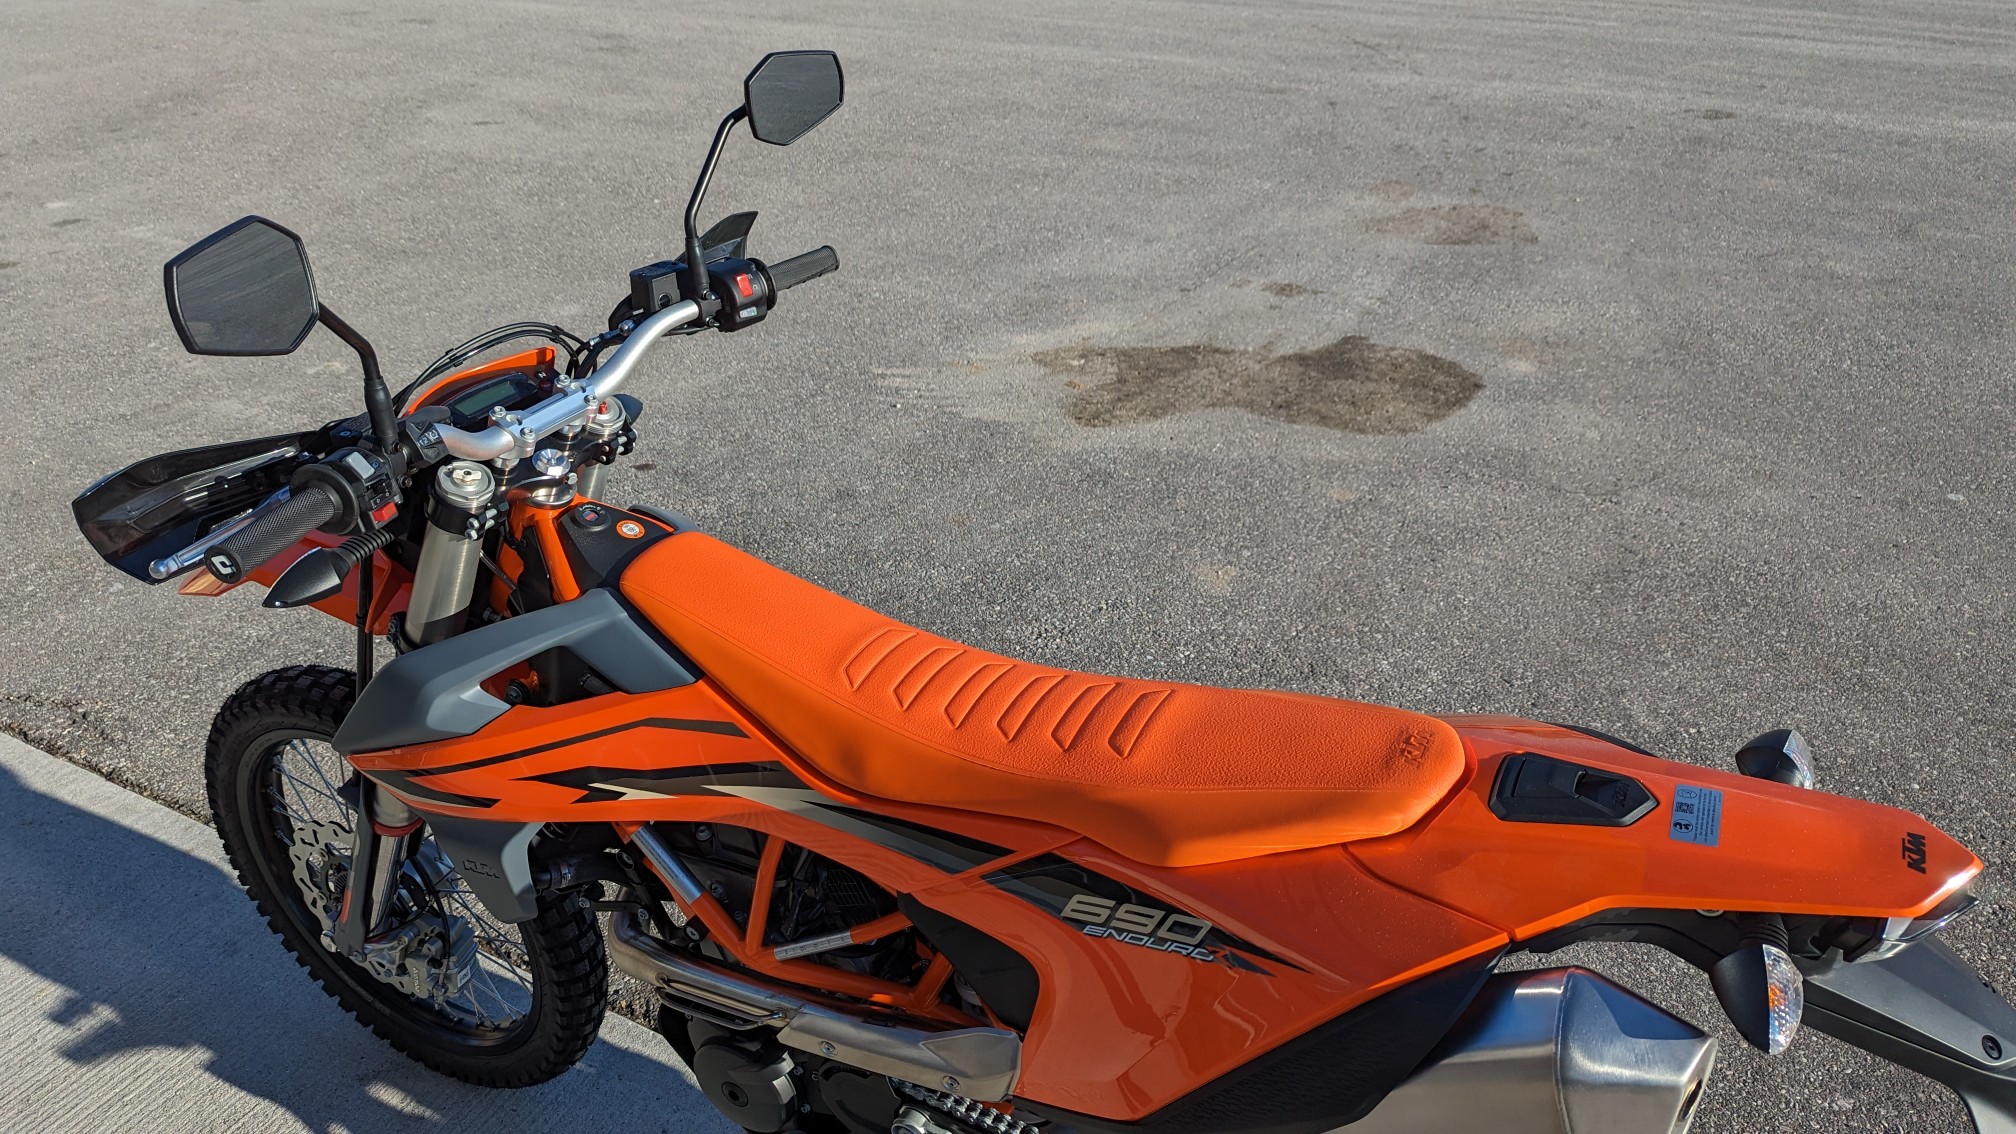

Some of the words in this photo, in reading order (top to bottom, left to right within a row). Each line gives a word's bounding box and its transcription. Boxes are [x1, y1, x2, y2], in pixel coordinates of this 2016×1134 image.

[1902, 832, 1926, 875] KTM
[1060, 894, 1213, 945] 690
[1082, 925, 1215, 962] ENDURO
